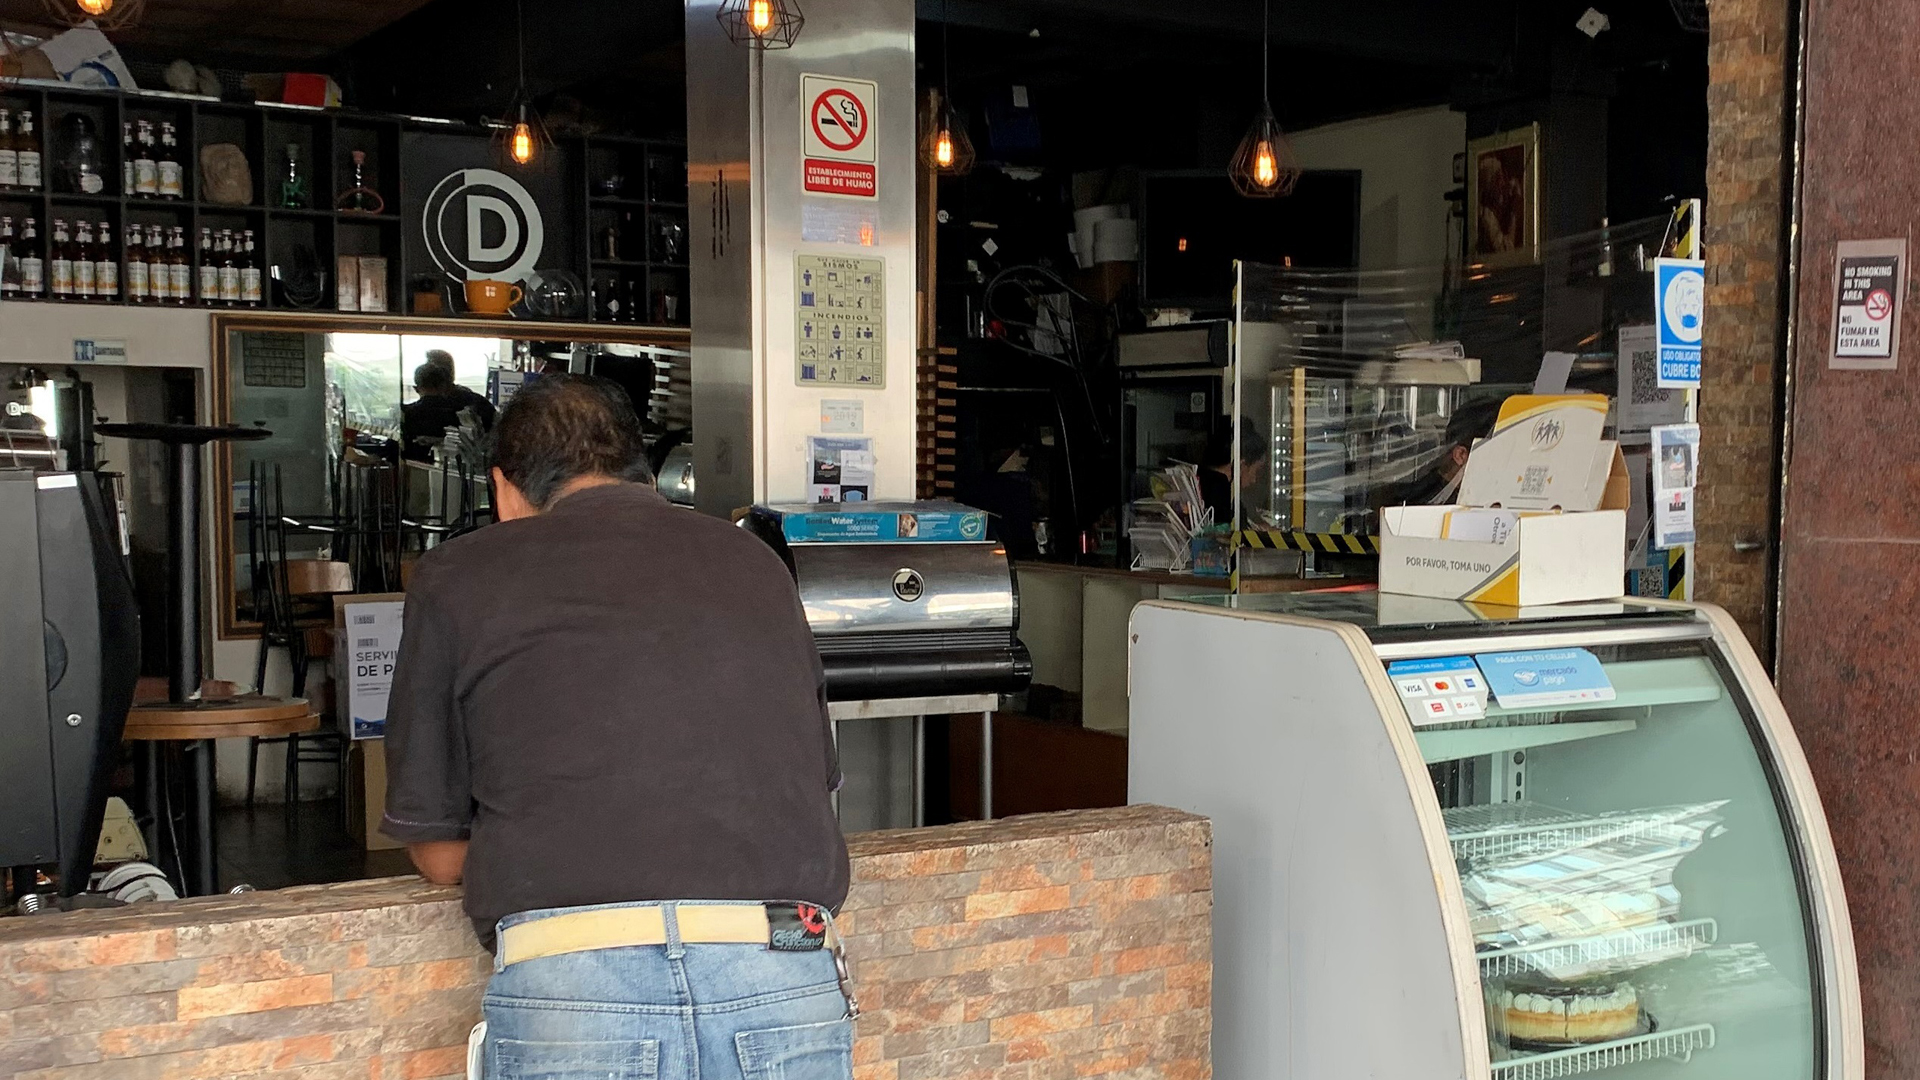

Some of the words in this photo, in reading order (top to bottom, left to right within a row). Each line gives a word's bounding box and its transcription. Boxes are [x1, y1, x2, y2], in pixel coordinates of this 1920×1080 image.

[808, 167, 872, 179] ESTABLECIMIENTO
[807, 175, 830, 185] LIBRE
[832, 178, 844, 187] DE
[846, 179, 873, 189] HUMO
[823, 262, 859, 270] SISMOS
[1845, 267, 1856, 278] NO
[1857, 266, 1893, 277] SMOKING
[1844, 279, 1853, 289] IN
[1854, 278, 1871, 289] THIS
[1842, 290, 1863, 301] AREA
[813, 312, 869, 321] INCENDIOS
[1842, 316, 1852, 325] NO
[1841, 327, 1867, 336] FUMAR
[1869, 327, 1879, 336] EN
[1840, 339, 1858, 348] ESTA
[1663, 350, 1675, 360] USO
[1662, 363, 1689, 378] CUBRE
[1406, 556, 1421, 566] POR
[1423, 558, 1449, 571] FAVOR,
[1450, 560, 1472, 571] TOMA
[1473, 562, 1491, 573] UNO
[357, 665, 378, 677] DE
[1539, 666, 1577, 677] mercado
[1542, 676, 1566, 685] pago
[1404, 684, 1423, 693] VISA
